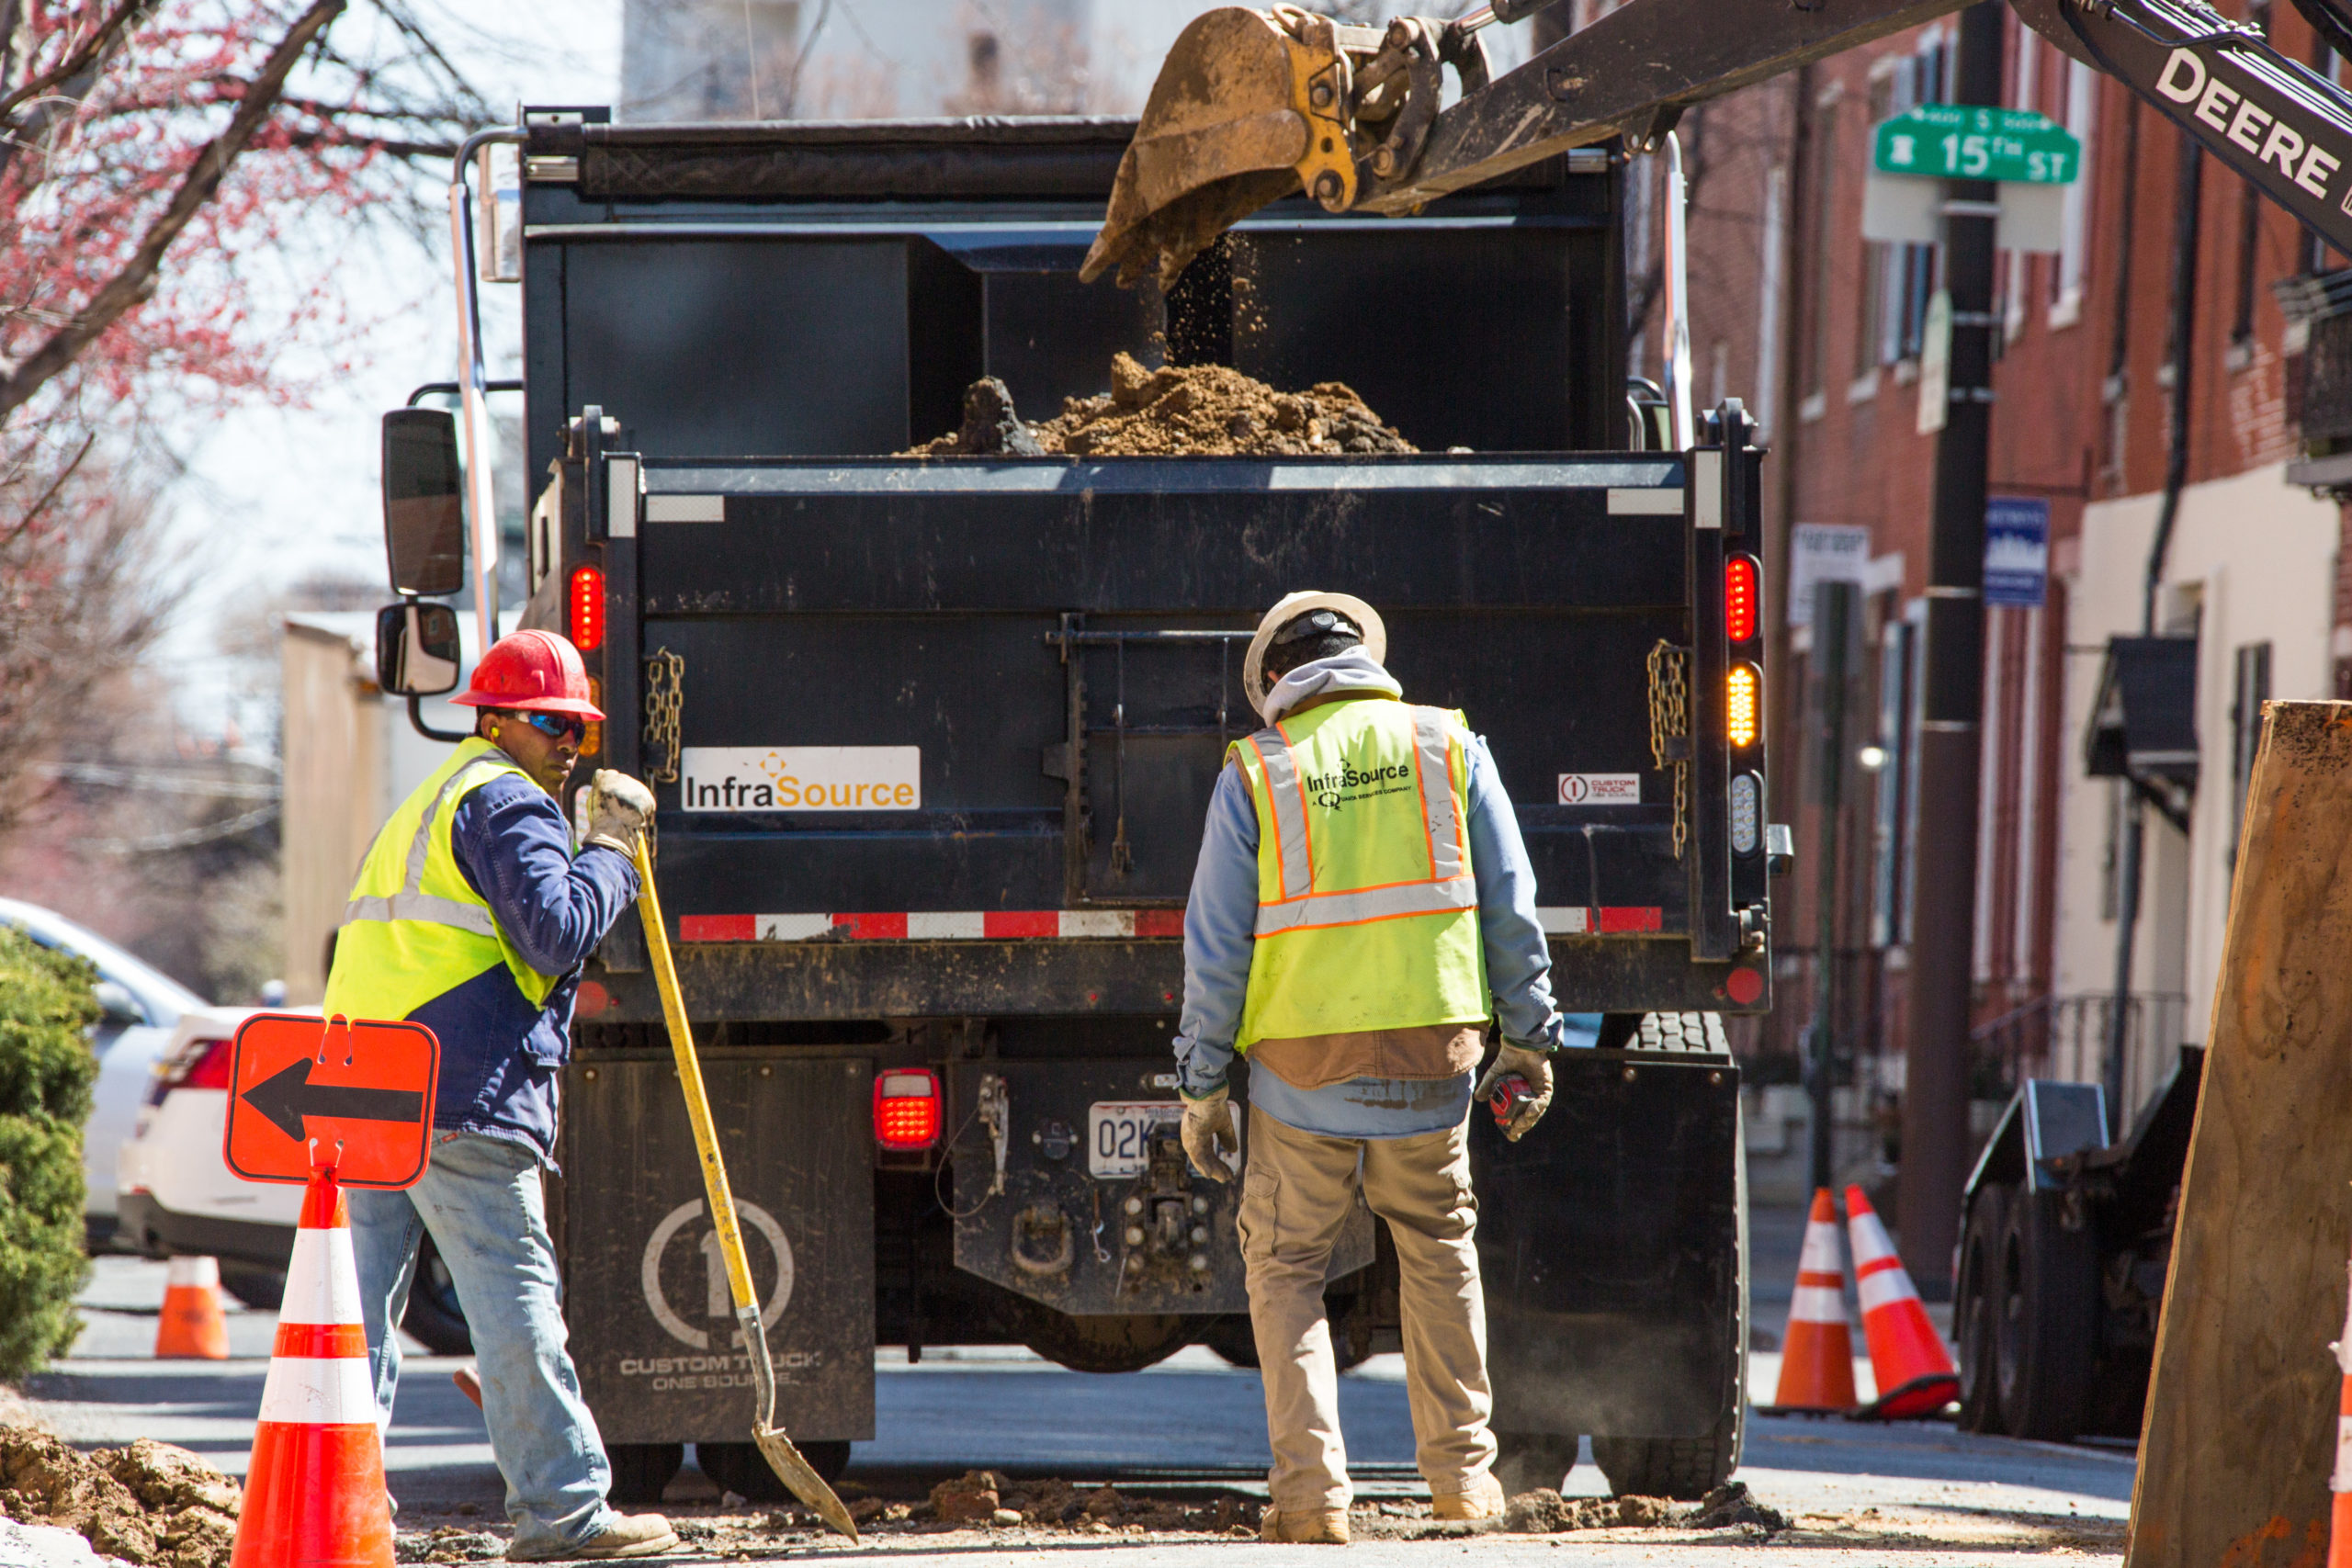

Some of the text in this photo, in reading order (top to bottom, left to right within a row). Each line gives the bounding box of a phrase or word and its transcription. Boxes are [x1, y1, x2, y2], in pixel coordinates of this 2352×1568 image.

[2155, 48, 2341, 199] DEERE
[2028, 152, 2065, 180] ST
[687, 775, 915, 807] InfraSource
[1307, 765, 1408, 792] InfraSource
[619, 1350, 821, 1374] CUSTOM TUCK
[652, 1376, 697, 1392] ONE
